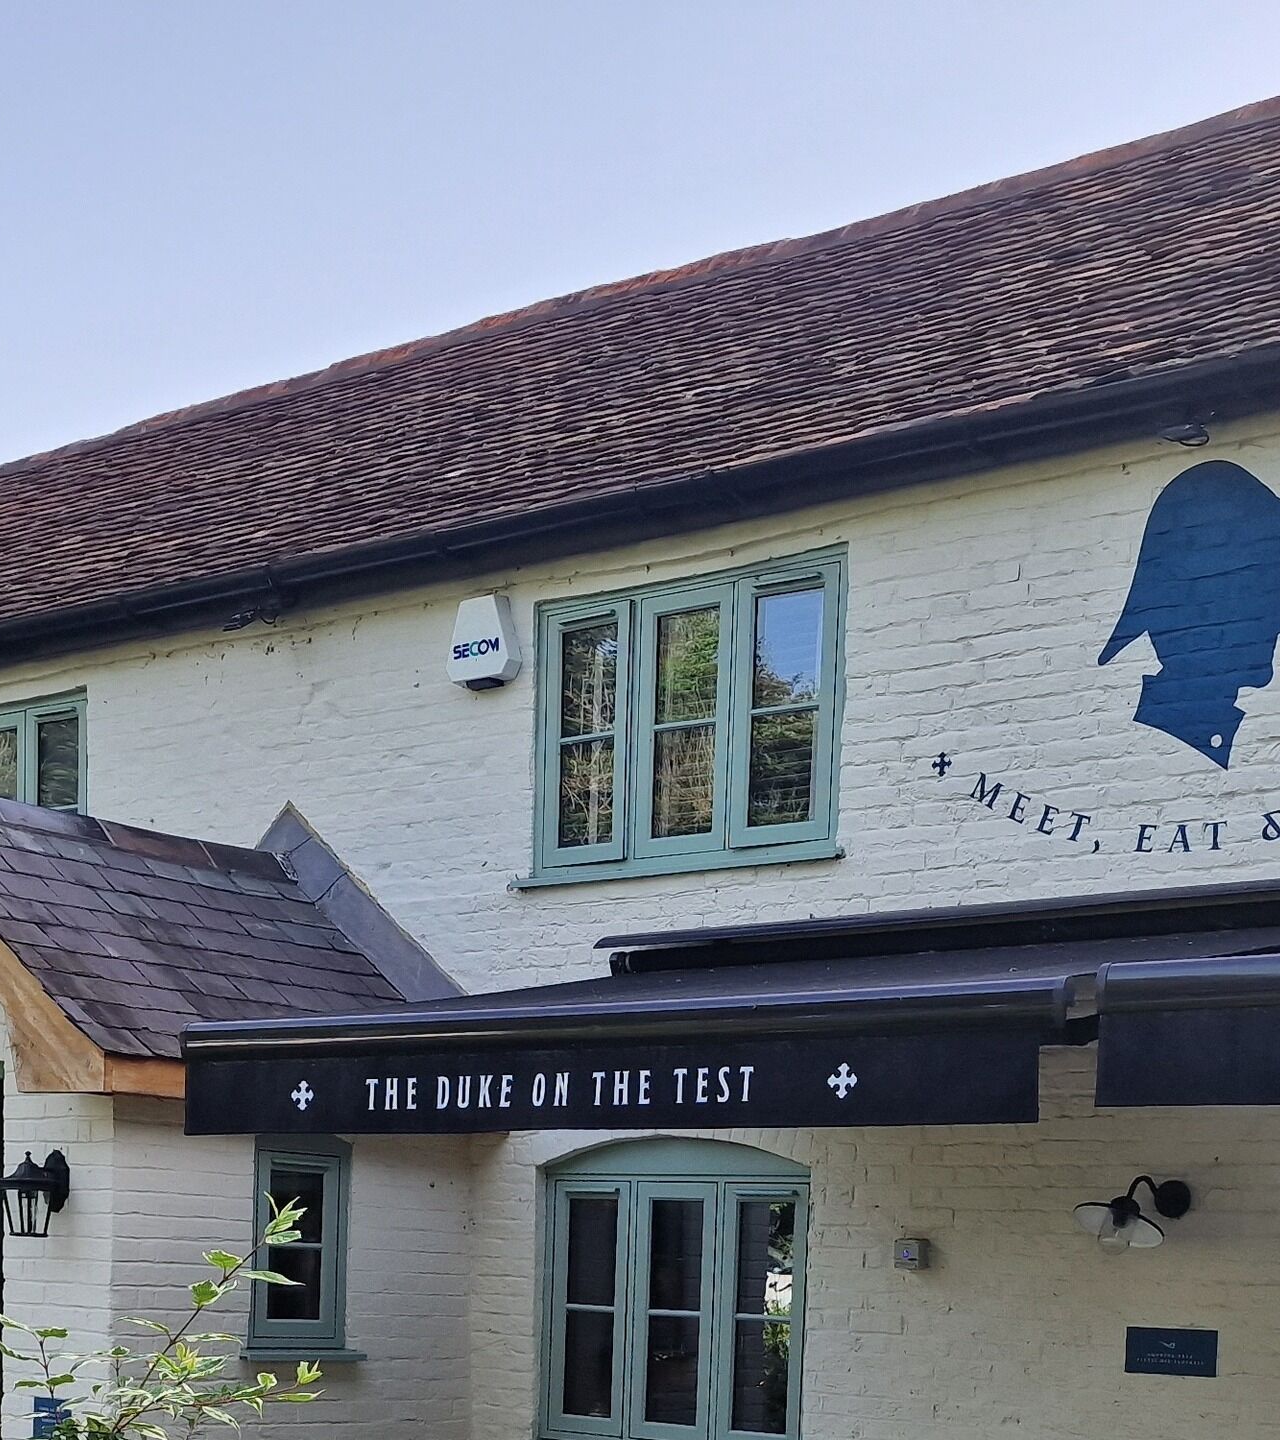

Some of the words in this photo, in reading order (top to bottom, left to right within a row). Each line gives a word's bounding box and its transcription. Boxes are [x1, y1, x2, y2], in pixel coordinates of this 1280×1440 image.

[453, 637, 500, 660] SECOM
[969, 771, 1102, 854] MEET,
[1133, 820, 1228, 853] EAT
[365, 1077, 418, 1111] THE
[436, 1074, 513, 1110] DUKE
[532, 1072, 570, 1107] ON
[591, 1069, 651, 1106] THE
[673, 1066, 754, 1104] TEST
